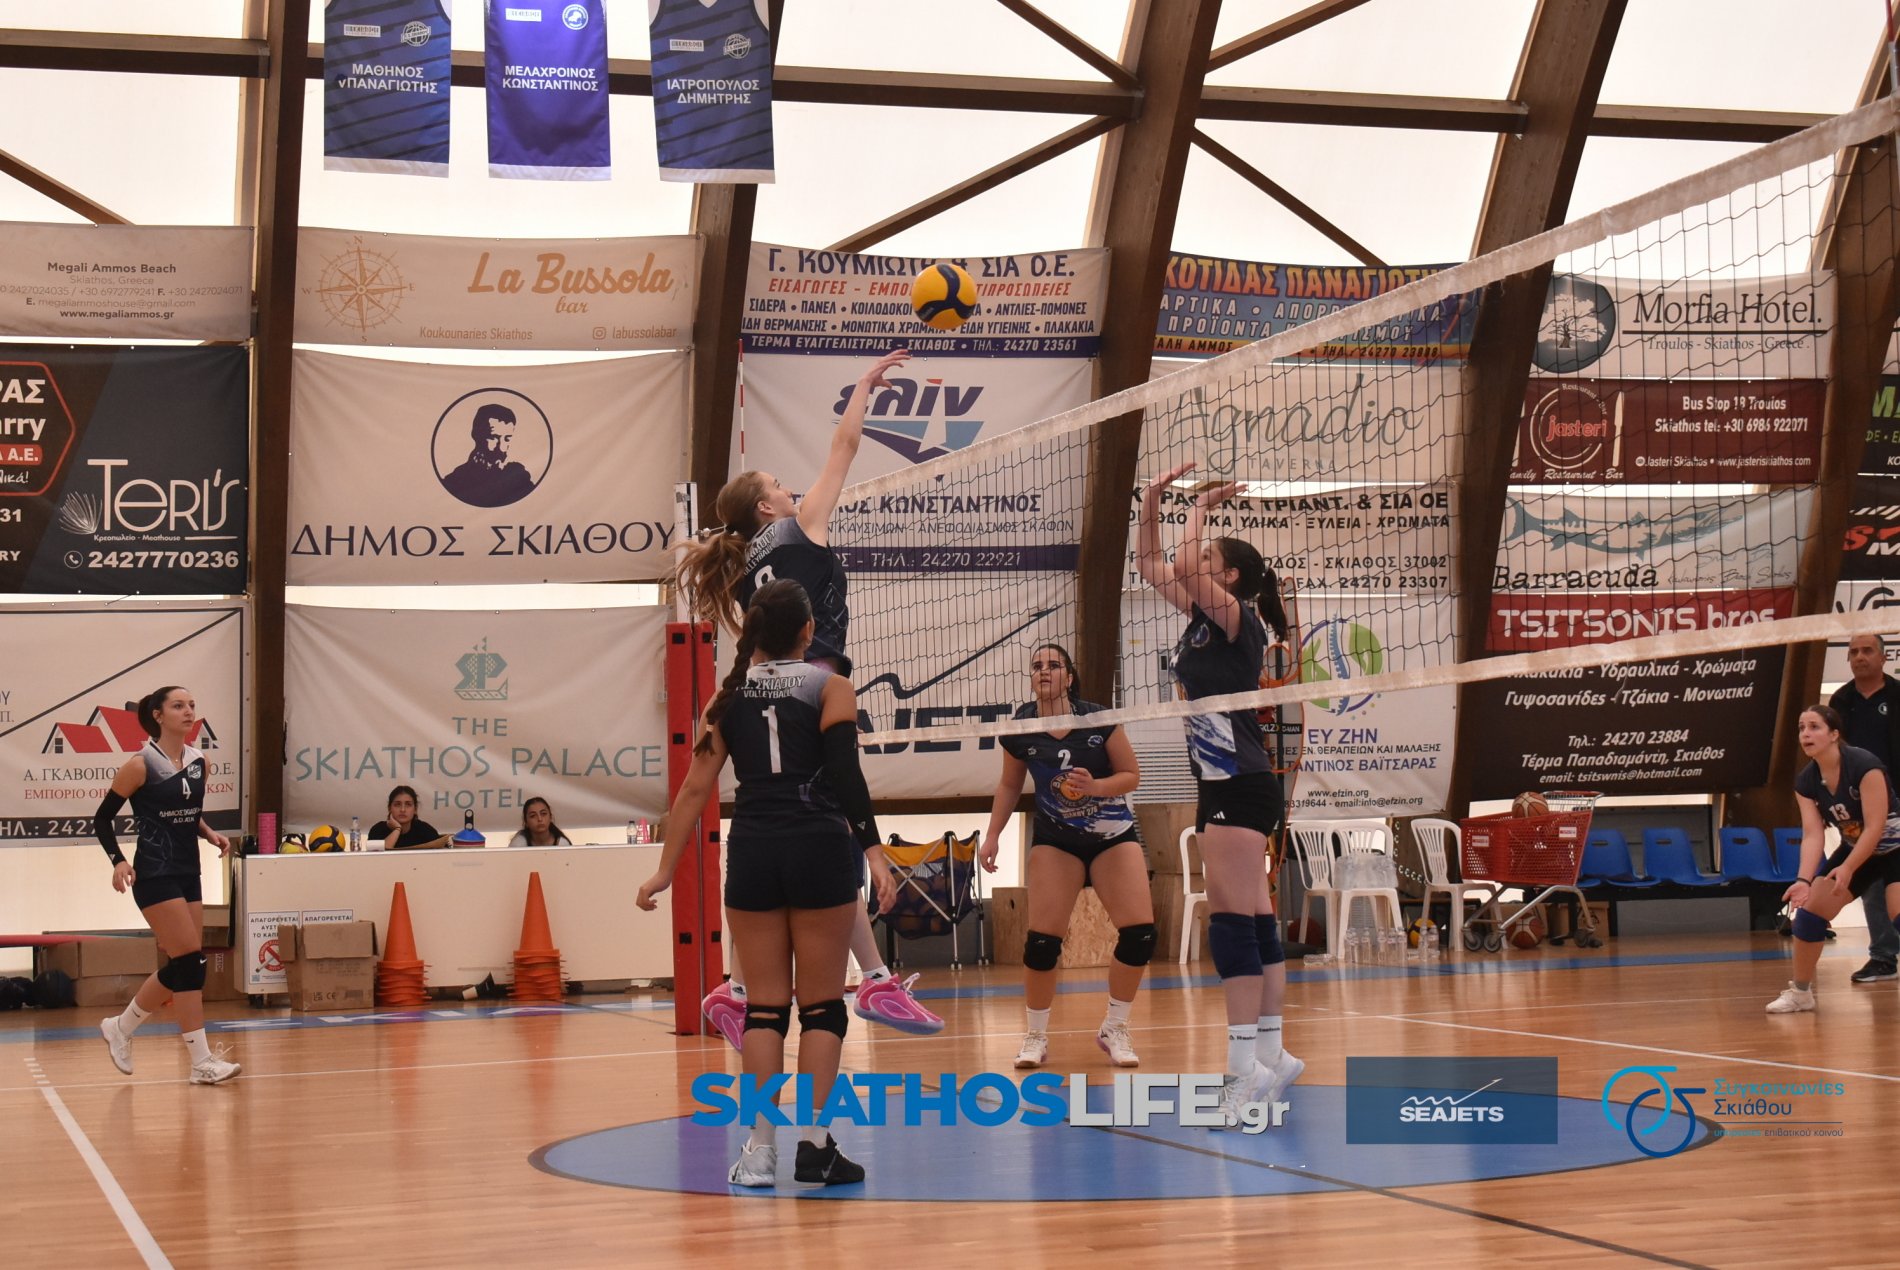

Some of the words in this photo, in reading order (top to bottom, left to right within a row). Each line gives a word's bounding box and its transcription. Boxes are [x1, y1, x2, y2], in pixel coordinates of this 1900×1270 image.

[352, 63, 424, 79] ΜΑΘΗΝΟΣ
[505, 64, 596, 79] ΜΕΛΑΧΡΟΙΝΟΣ
[502, 77, 599, 92] ΚΩΝΣΤΑΝΤΙΝΟΣ
[667, 78, 760, 92] ΙΑΤΡΟΠΟΥΛΟΣ
[677, 91, 752, 105] ΔΗΜΗΤΡΗΣ
[47, 262, 88, 275] Megali
[92, 263, 136, 273] Ammos
[141, 263, 176, 274] Beach
[769, 248, 786, 272] Γ.
[982, 256, 1020, 277] ΣΙΑ
[1031, 254, 1075, 277] Ο.Ε.
[467, 252, 525, 295] La
[532, 252, 674, 295] Bussola
[769, 278, 847, 295] ΕΙΣΑΓΩΓΕΣ
[976, 282, 1072, 296] ΤΙΠΡΟΣΩΠΕΙΕΣ
[555, 296, 588, 315] bar
[750, 298, 786, 313] ΣΙΔΕΡΑ
[801, 301, 837, 314] ΠΑΝΕΛ
[995, 302, 1087, 316] ΑΝΤΛΙΕΣ-ΠΟΜΟΝΕΣ
[1633, 293, 1730, 325] Morfia
[1739, 293, 1822, 325] Hotel.
[60, 310, 174, 321] www.megaliammos.gr
[420, 327, 487, 341] Koukounaries
[490, 328, 533, 341] Skiathos
[612, 327, 677, 340] labussolabar
[764, 318, 828, 332] ΘΕΡΜΑΝΣΗΣ
[840, 320, 895, 334] ΜΟΝΩΤΙΚΑ
[960, 322, 983, 335] ΕΙΔΗ
[987, 321, 1031, 334] ΥΓΙΕΙΝΗΣ
[1044, 320, 1094, 334] ΠΛΑΚΑΚΙΑ
[1168, 316, 1272, 338] ΠΡΟΪΟΝΤΑ
[751, 335, 790, 348] ΤΕΡΜΑ
[796, 336, 893, 350] ΕΥΑΓΓΕΛΙΣΤΡΙΑΣ
[907, 339, 956, 351] ΣΚΙΑΘΟΣ
[1003, 339, 1039, 351] 24270
[1044, 339, 1077, 351] 23561
[1154, 337, 1184, 350] ΑΛΗ
[1188, 340, 1233, 352] ΑΜΜΟΣ
[1703, 337, 1754, 351] Skiathos
[1682, 396, 1704, 410] Bus
[1706, 396, 1730, 413] Stop
[1655, 418, 1701, 433] Skiathos
[1723, 418, 1744, 433] +30
[1773, 417, 1808, 432] 922071
[880, 495, 1041, 514] ΚΩΝΣΤΑΝΤΙΝΟΣ
[1380, 493, 1413, 509] ΣΙΑ
[838, 522, 905, 534] ΚΑΥΣΙΜΩΝ
[1022, 520, 1073, 533] ΣΚΑΦΩΝ
[1306, 517, 1361, 529] ΞΥΛΕΙΑ
[291, 524, 465, 557] ΔΗΜΟΣ
[488, 521, 676, 556] ΣΚΙΑΘΟΥ
[88, 551, 239, 568] 2427770236
[921, 552, 970, 567] 24270
[1325, 557, 1397, 569] ΣΚΙΑΘΟΣ
[1340, 576, 1391, 589] 24270
[1399, 576, 1448, 588] 23307
[1492, 564, 1658, 590] Barracuda
[1496, 607, 1696, 639] TSITSONIS
[744, 688, 792, 699] VOLLEYBALL
[1505, 690, 1606, 710] Γυψοσανίδες
[1621, 688, 1669, 707] Τζάκια
[1683, 682, 1754, 703] Μονωτικά
[452, 717, 508, 737] THE
[762, 705, 782, 774] 1
[1308, 728, 1334, 745] ΕΥ
[1338, 728, 1378, 745] ΖΗΝ
[1602, 731, 1646, 747] 24270
[1647, 729, 1689, 744] 23884
[1377, 745, 1393, 754] ΚΑΙ
[1396, 743, 1442, 754] ΜΑΛΑΞΗΣ
[296, 745, 491, 782] SKIATHOS
[511, 745, 662, 777] PALACE
[1058, 749, 1074, 770] 2
[1359, 756, 1438, 772] ΒΑΪΤΣΑΡΑΣ
[1521, 753, 1563, 770] Τέρμα
[1674, 746, 1725, 763] Σκιάθος
[1539, 772, 1576, 785] email:
[1578, 765, 1703, 783] tsitswnis@hotmail.com
[25, 789, 86, 800] ΕΜΠΟΡΙΟ
[182, 777, 192, 800] 4
[1307, 789, 1369, 799] www.efzin.org
[433, 787, 524, 810] HOTEL
[1829, 803, 1851, 822] 13
